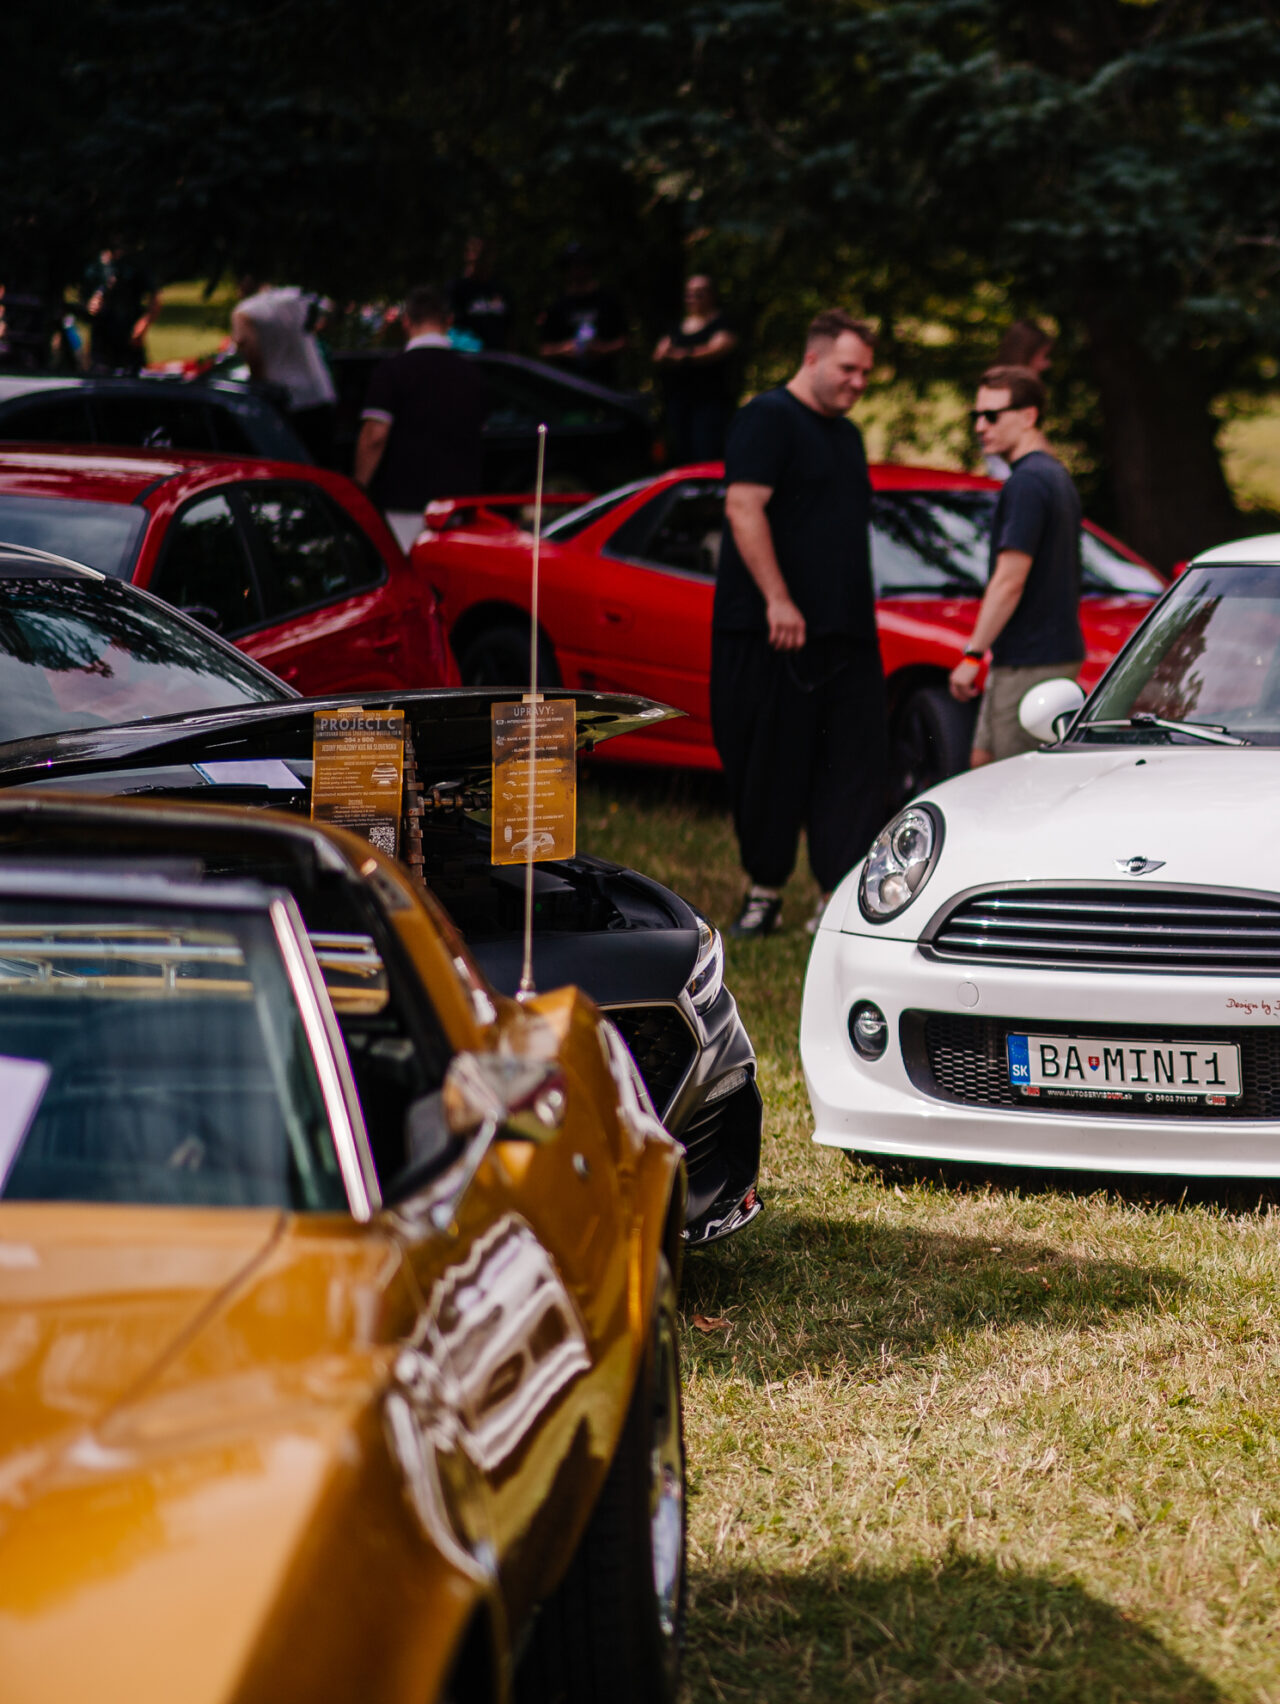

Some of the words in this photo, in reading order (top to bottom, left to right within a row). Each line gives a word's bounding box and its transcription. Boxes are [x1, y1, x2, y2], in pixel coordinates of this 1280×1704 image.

[320, 717, 382, 731] PROJECT
[386, 716, 396, 730] C
[1226, 998, 1258, 1015] Design
[1261, 1000, 1272, 1015] by
[1012, 1064, 1029, 1077] SK
[1039, 1043, 1085, 1080] BA
[1103, 1047, 1226, 1086] MINI1
